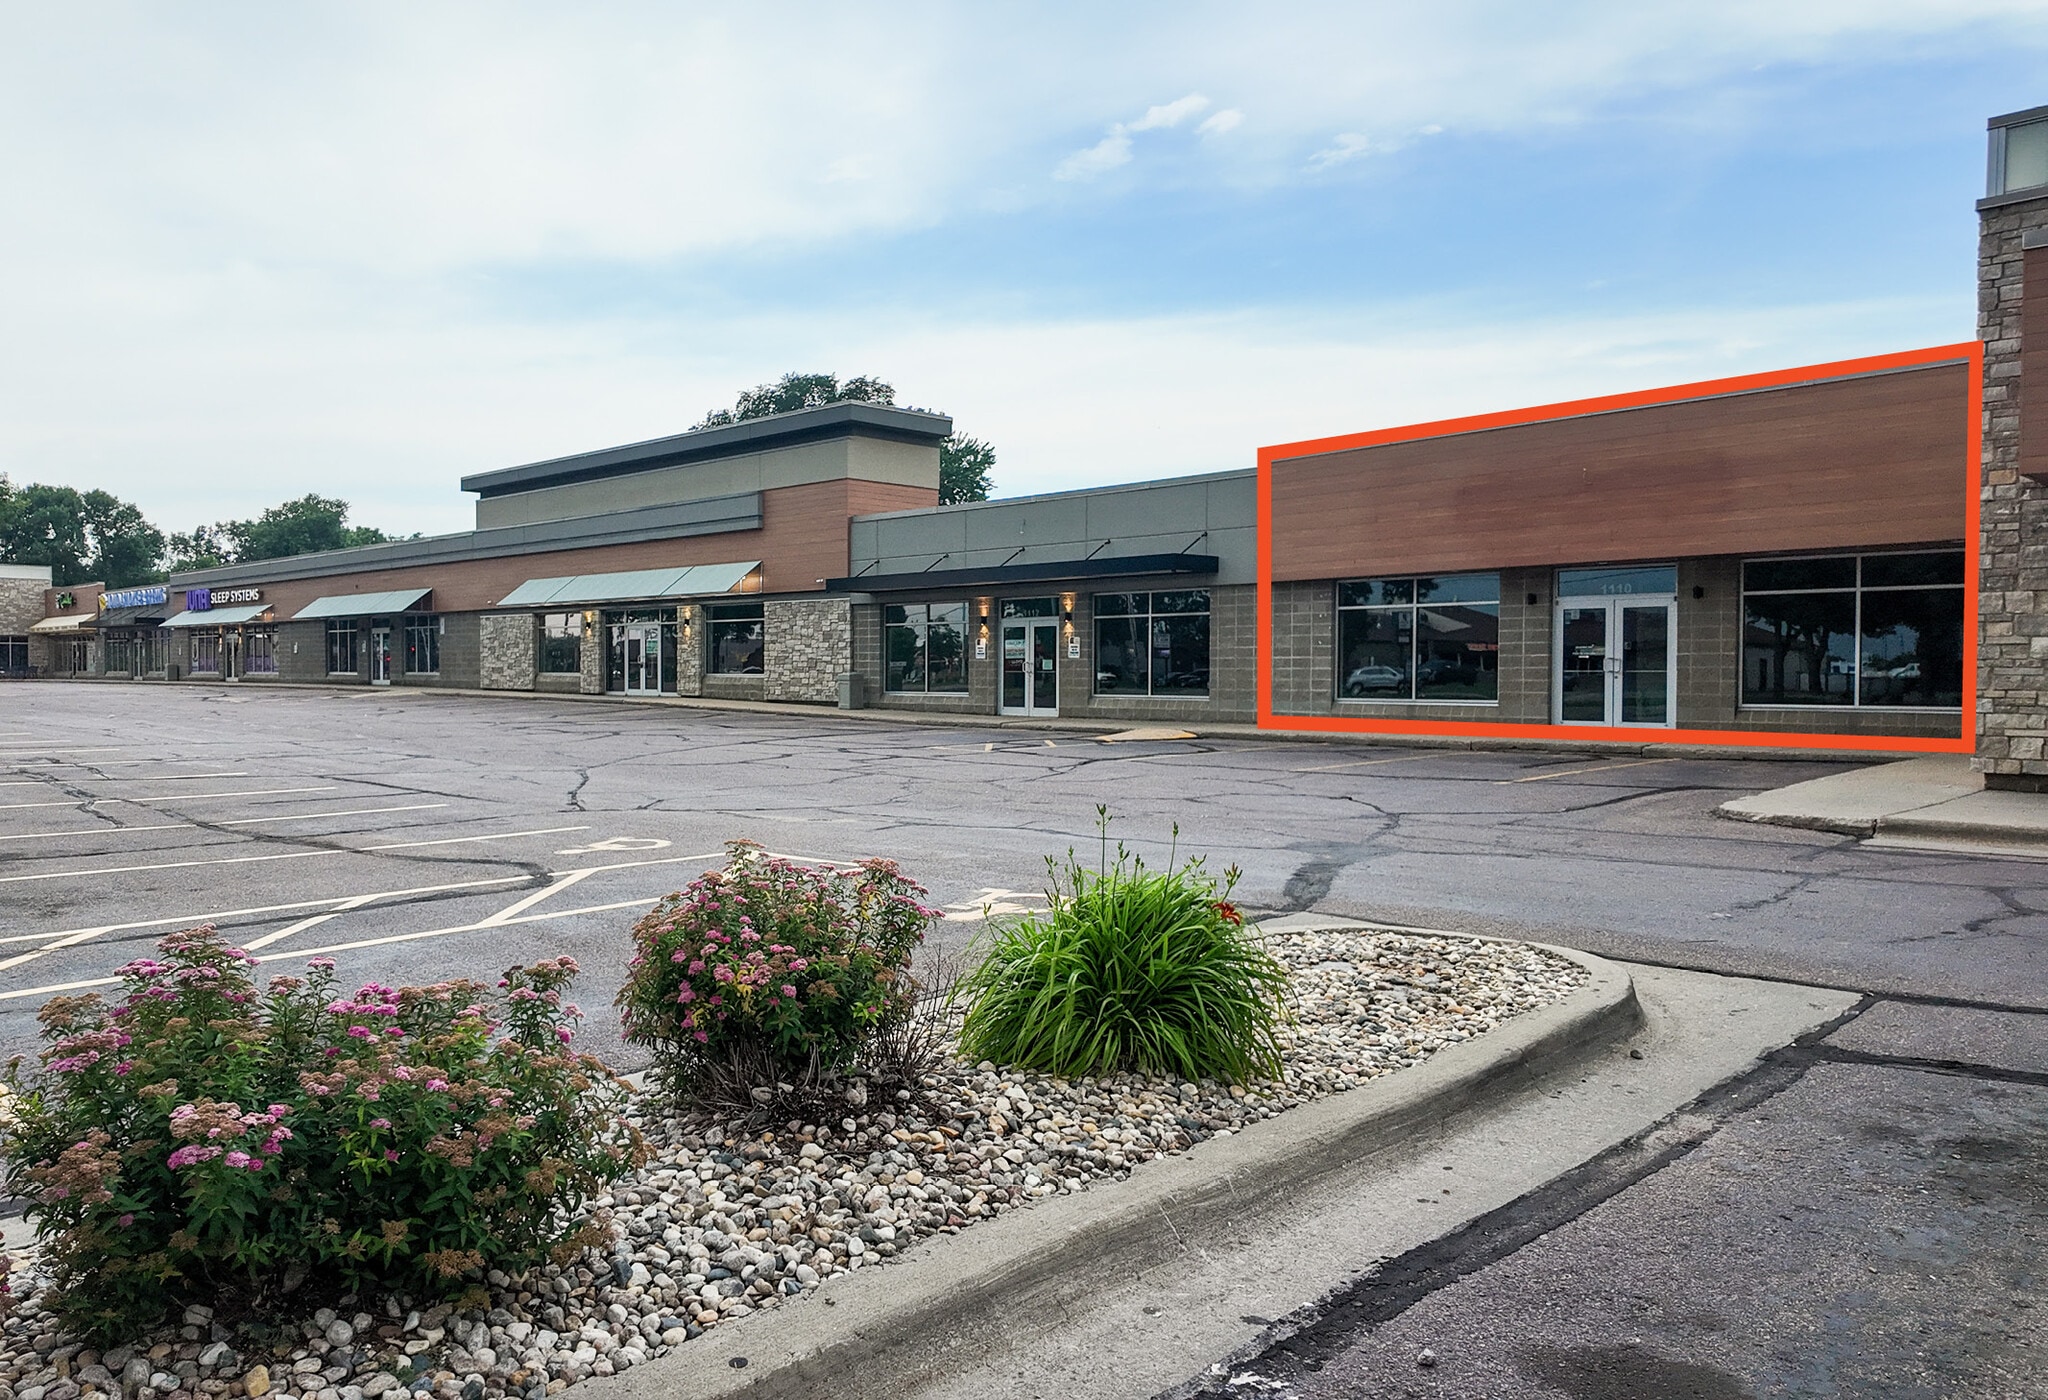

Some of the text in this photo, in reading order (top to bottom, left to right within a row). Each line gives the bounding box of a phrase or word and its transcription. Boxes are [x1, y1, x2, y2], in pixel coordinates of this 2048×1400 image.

[1600, 583, 1632, 594] 1110
[210, 591, 229, 604] SLEEP
[230, 588, 259, 602] SYSTEMS
